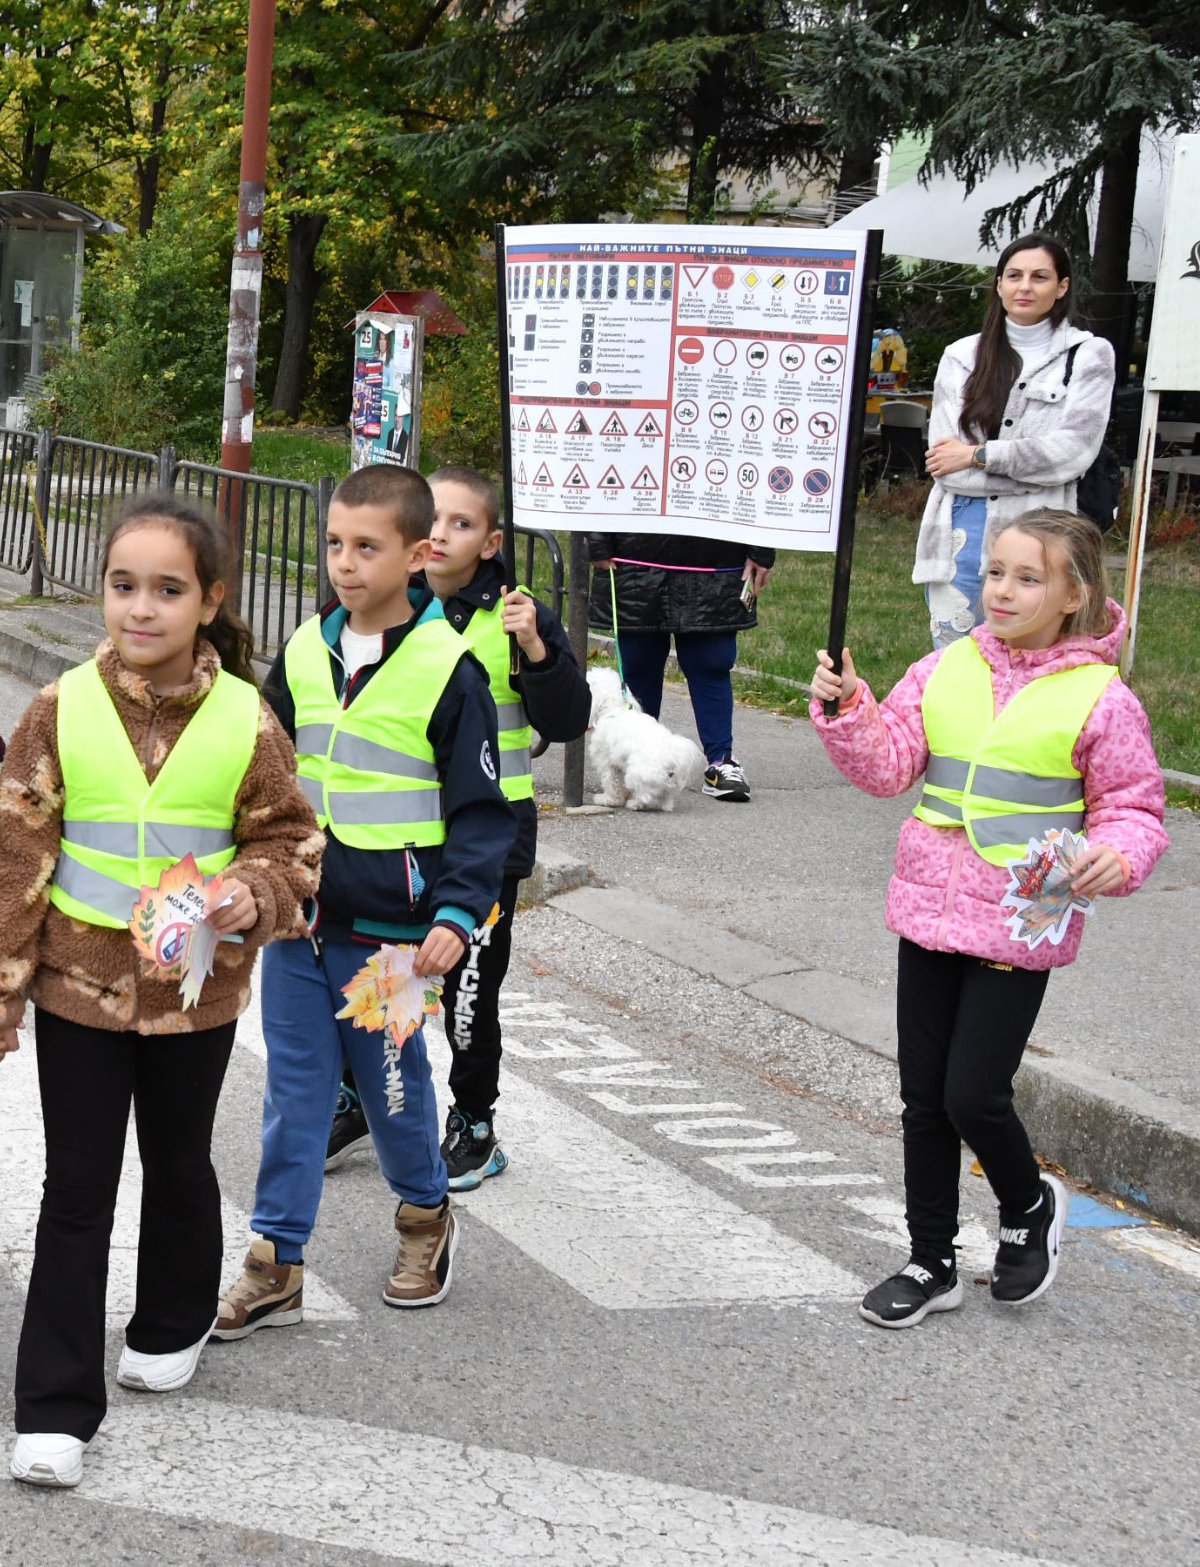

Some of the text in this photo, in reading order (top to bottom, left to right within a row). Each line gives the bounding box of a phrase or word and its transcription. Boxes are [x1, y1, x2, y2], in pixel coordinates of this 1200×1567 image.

[712, 247, 748, 255] ЗНАЦИ
[362, 331, 371, 343] 25
[742, 470, 753, 482] 50
[165, 894, 190, 915] може
[454, 925, 495, 1051] MICKEY
[999, 1227, 1030, 1246] NIKE
[900, 1263, 933, 1285] NIKE
